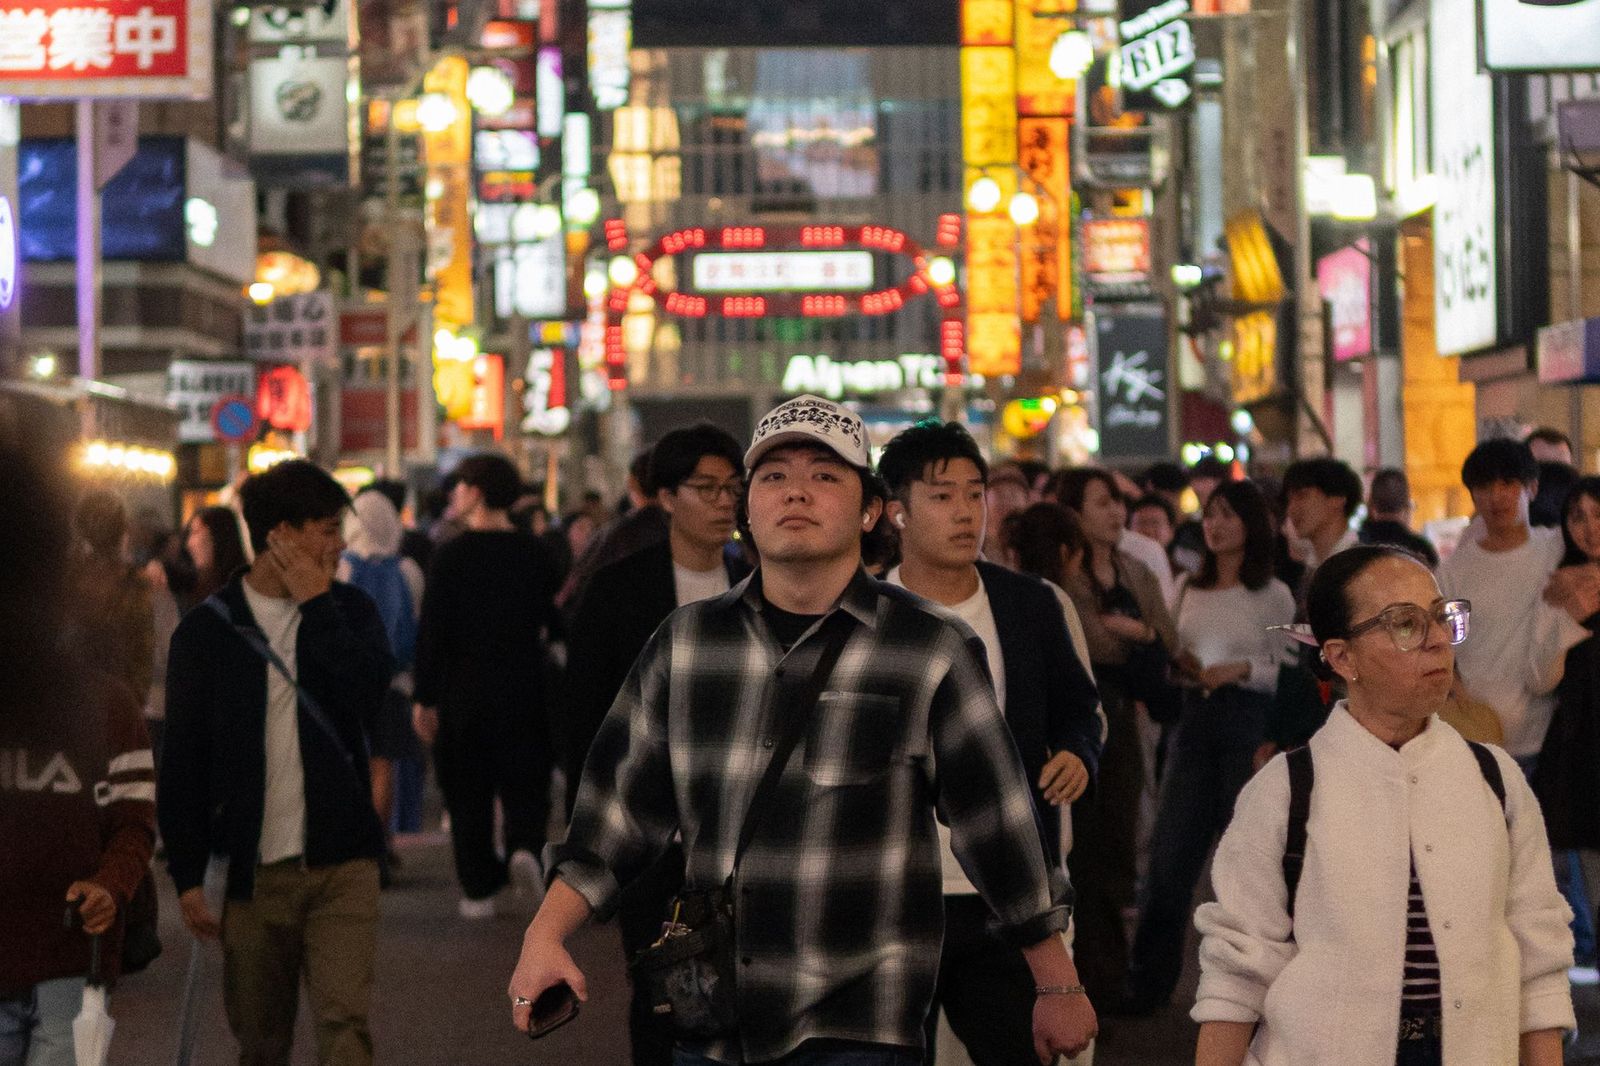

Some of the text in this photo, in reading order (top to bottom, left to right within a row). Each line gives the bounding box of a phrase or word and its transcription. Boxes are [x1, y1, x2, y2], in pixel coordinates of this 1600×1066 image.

[0, 8, 176, 70] 営業中
[783, 354, 902, 397] Alpen
